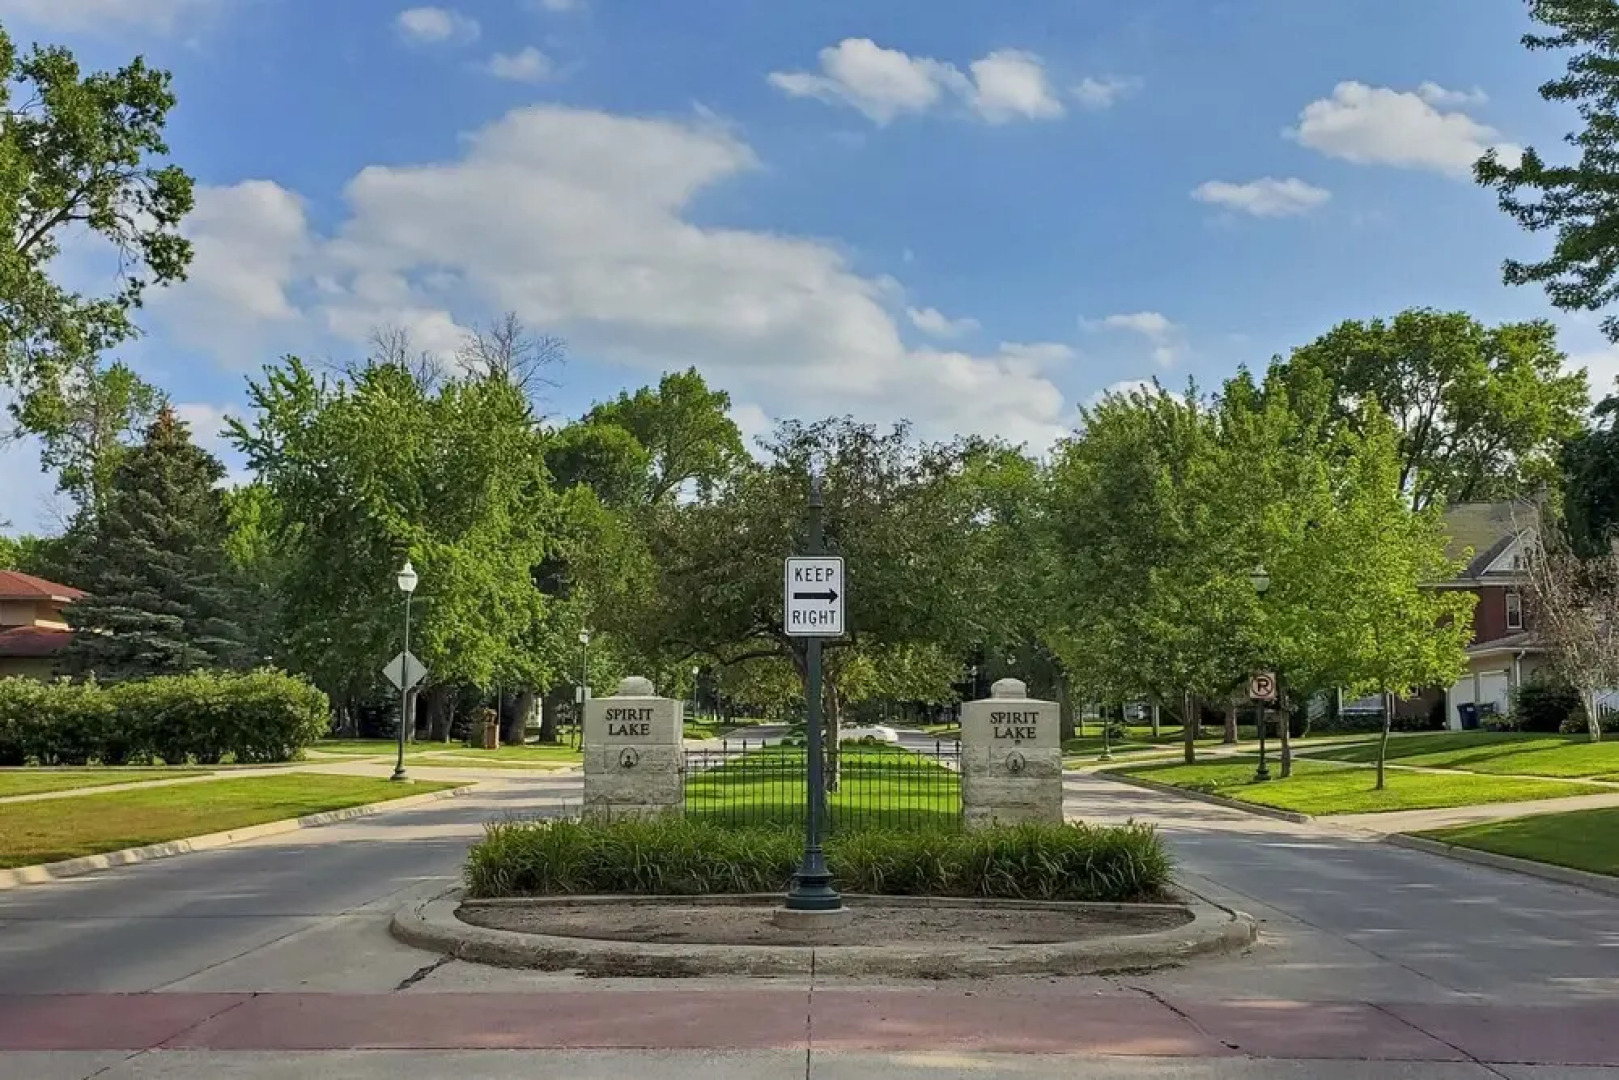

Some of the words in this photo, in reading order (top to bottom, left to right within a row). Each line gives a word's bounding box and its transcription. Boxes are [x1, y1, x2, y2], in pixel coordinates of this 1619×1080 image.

[794, 567, 835, 582] KEEP
[792, 609, 836, 624] RIGHT
[605, 708, 654, 721] SPIRIT
[990, 712, 1039, 724] SPIRIT
[608, 723, 651, 736] LAKE
[993, 726, 1037, 739] LAKE
